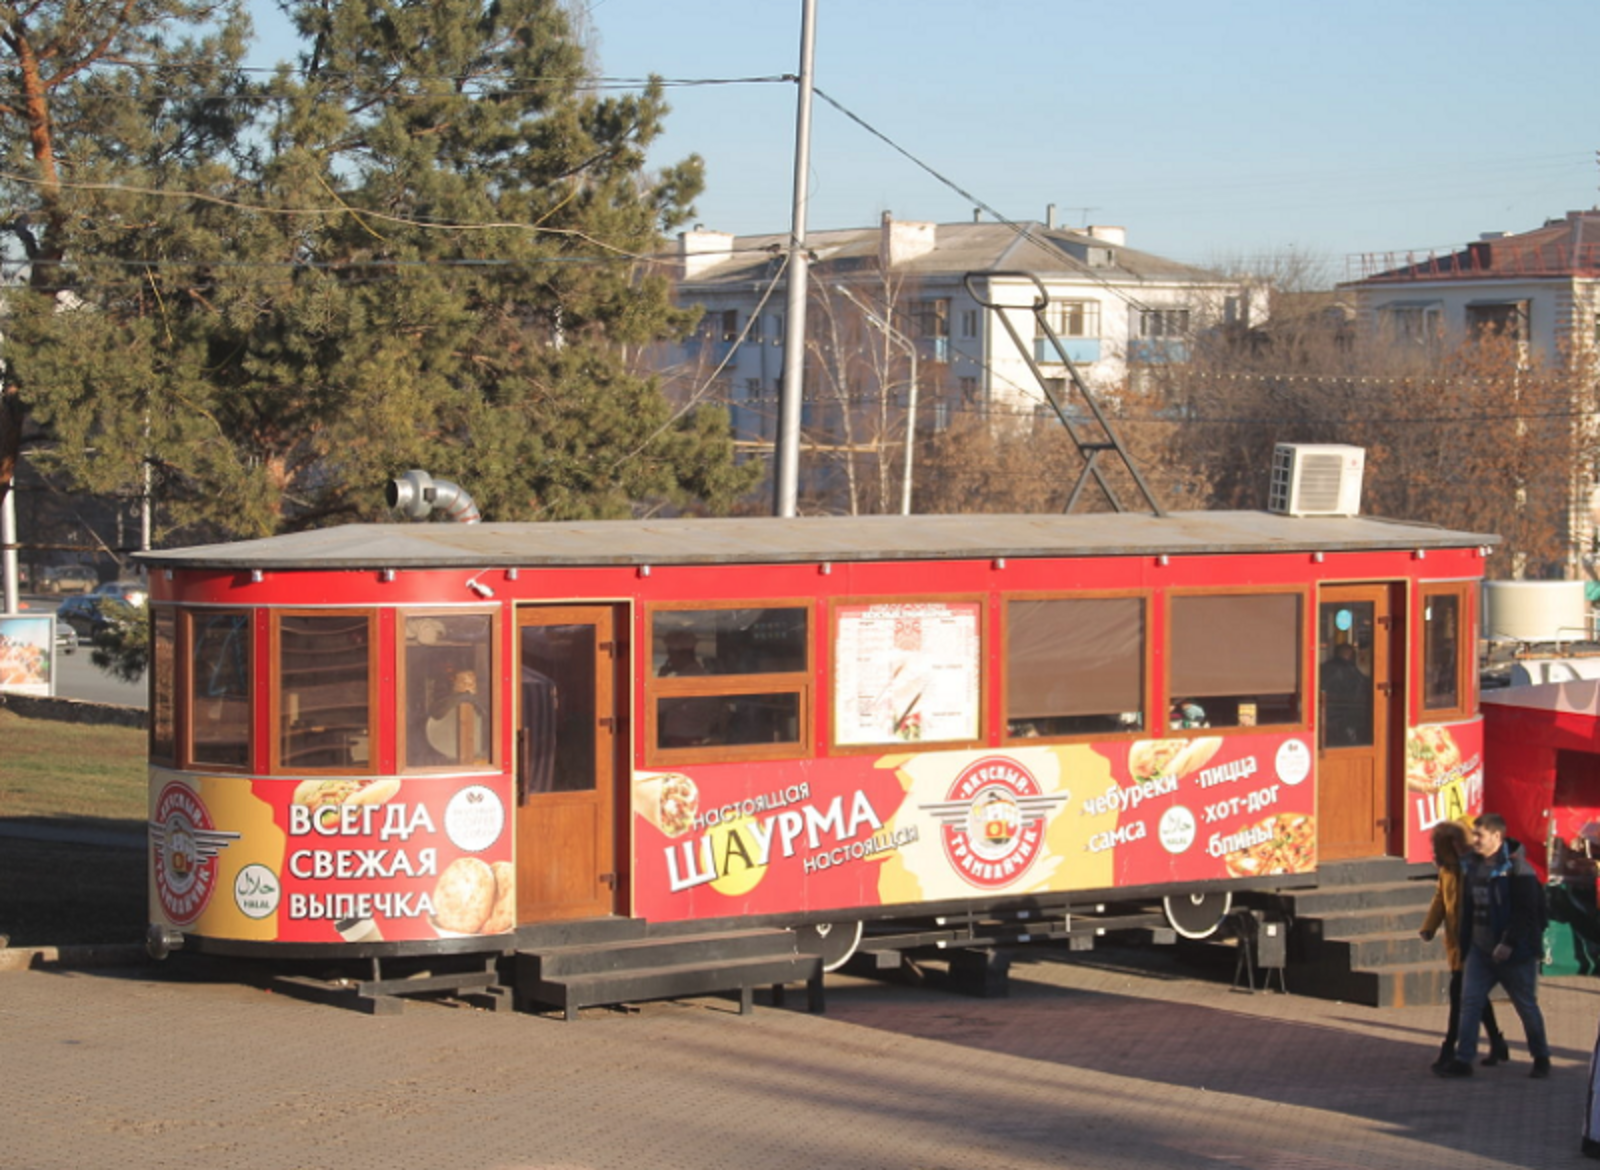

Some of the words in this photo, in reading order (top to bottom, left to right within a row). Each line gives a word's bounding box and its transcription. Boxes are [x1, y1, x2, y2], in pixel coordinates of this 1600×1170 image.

[1199, 756, 1258, 788] пицца
[1083, 773, 1178, 815] чебуреки
[1204, 784, 1280, 823] хот-дог
[289, 803, 436, 841] ВСЕГДА
[663, 789, 884, 893] ШАУРМА
[1089, 821, 1147, 853] самса
[1209, 816, 1277, 858] блины
[289, 848, 438, 879] СВЕЖАЯ
[289, 893, 437, 920] ВЫПЕЧКА
